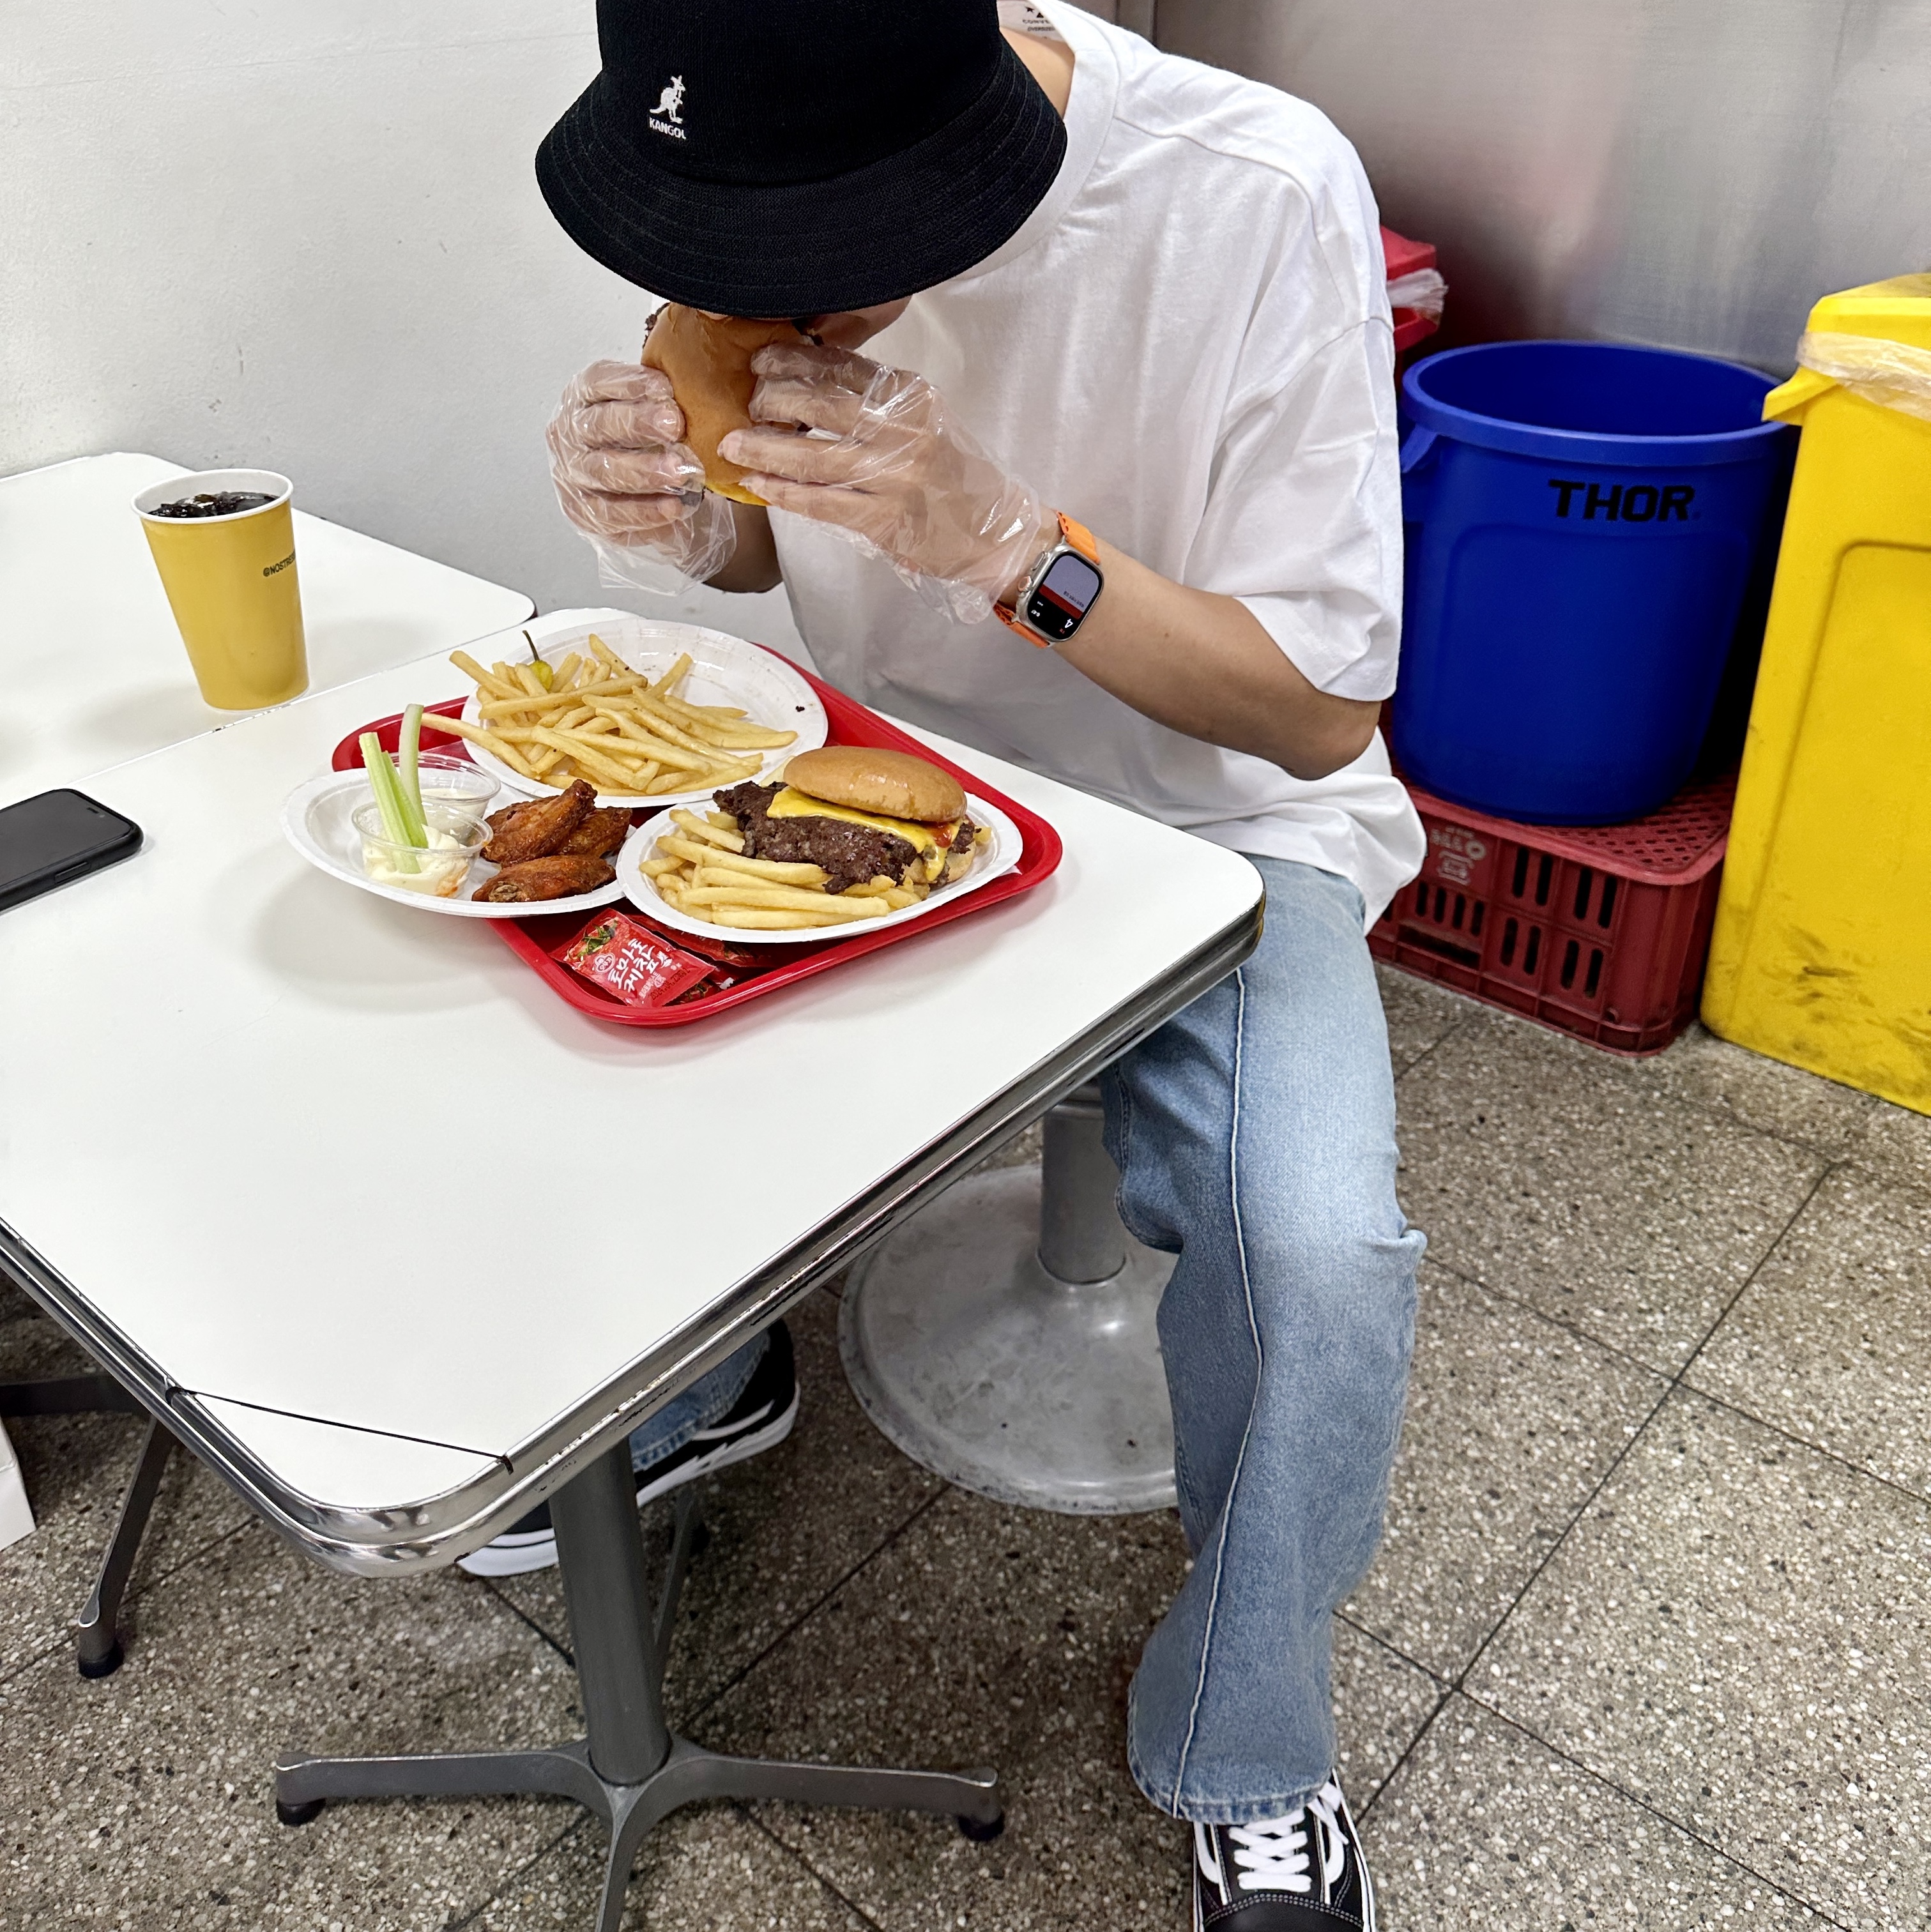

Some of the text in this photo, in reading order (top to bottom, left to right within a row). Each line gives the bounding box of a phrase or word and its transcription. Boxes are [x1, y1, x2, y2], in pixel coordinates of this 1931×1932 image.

[649, 116, 686, 140] KANGOL
[1548, 478, 1695, 521] THOR
[1065, 618, 1073, 628] 4
[607, 938, 648, 989] 토마토
[623, 946, 659, 993] 케찹
